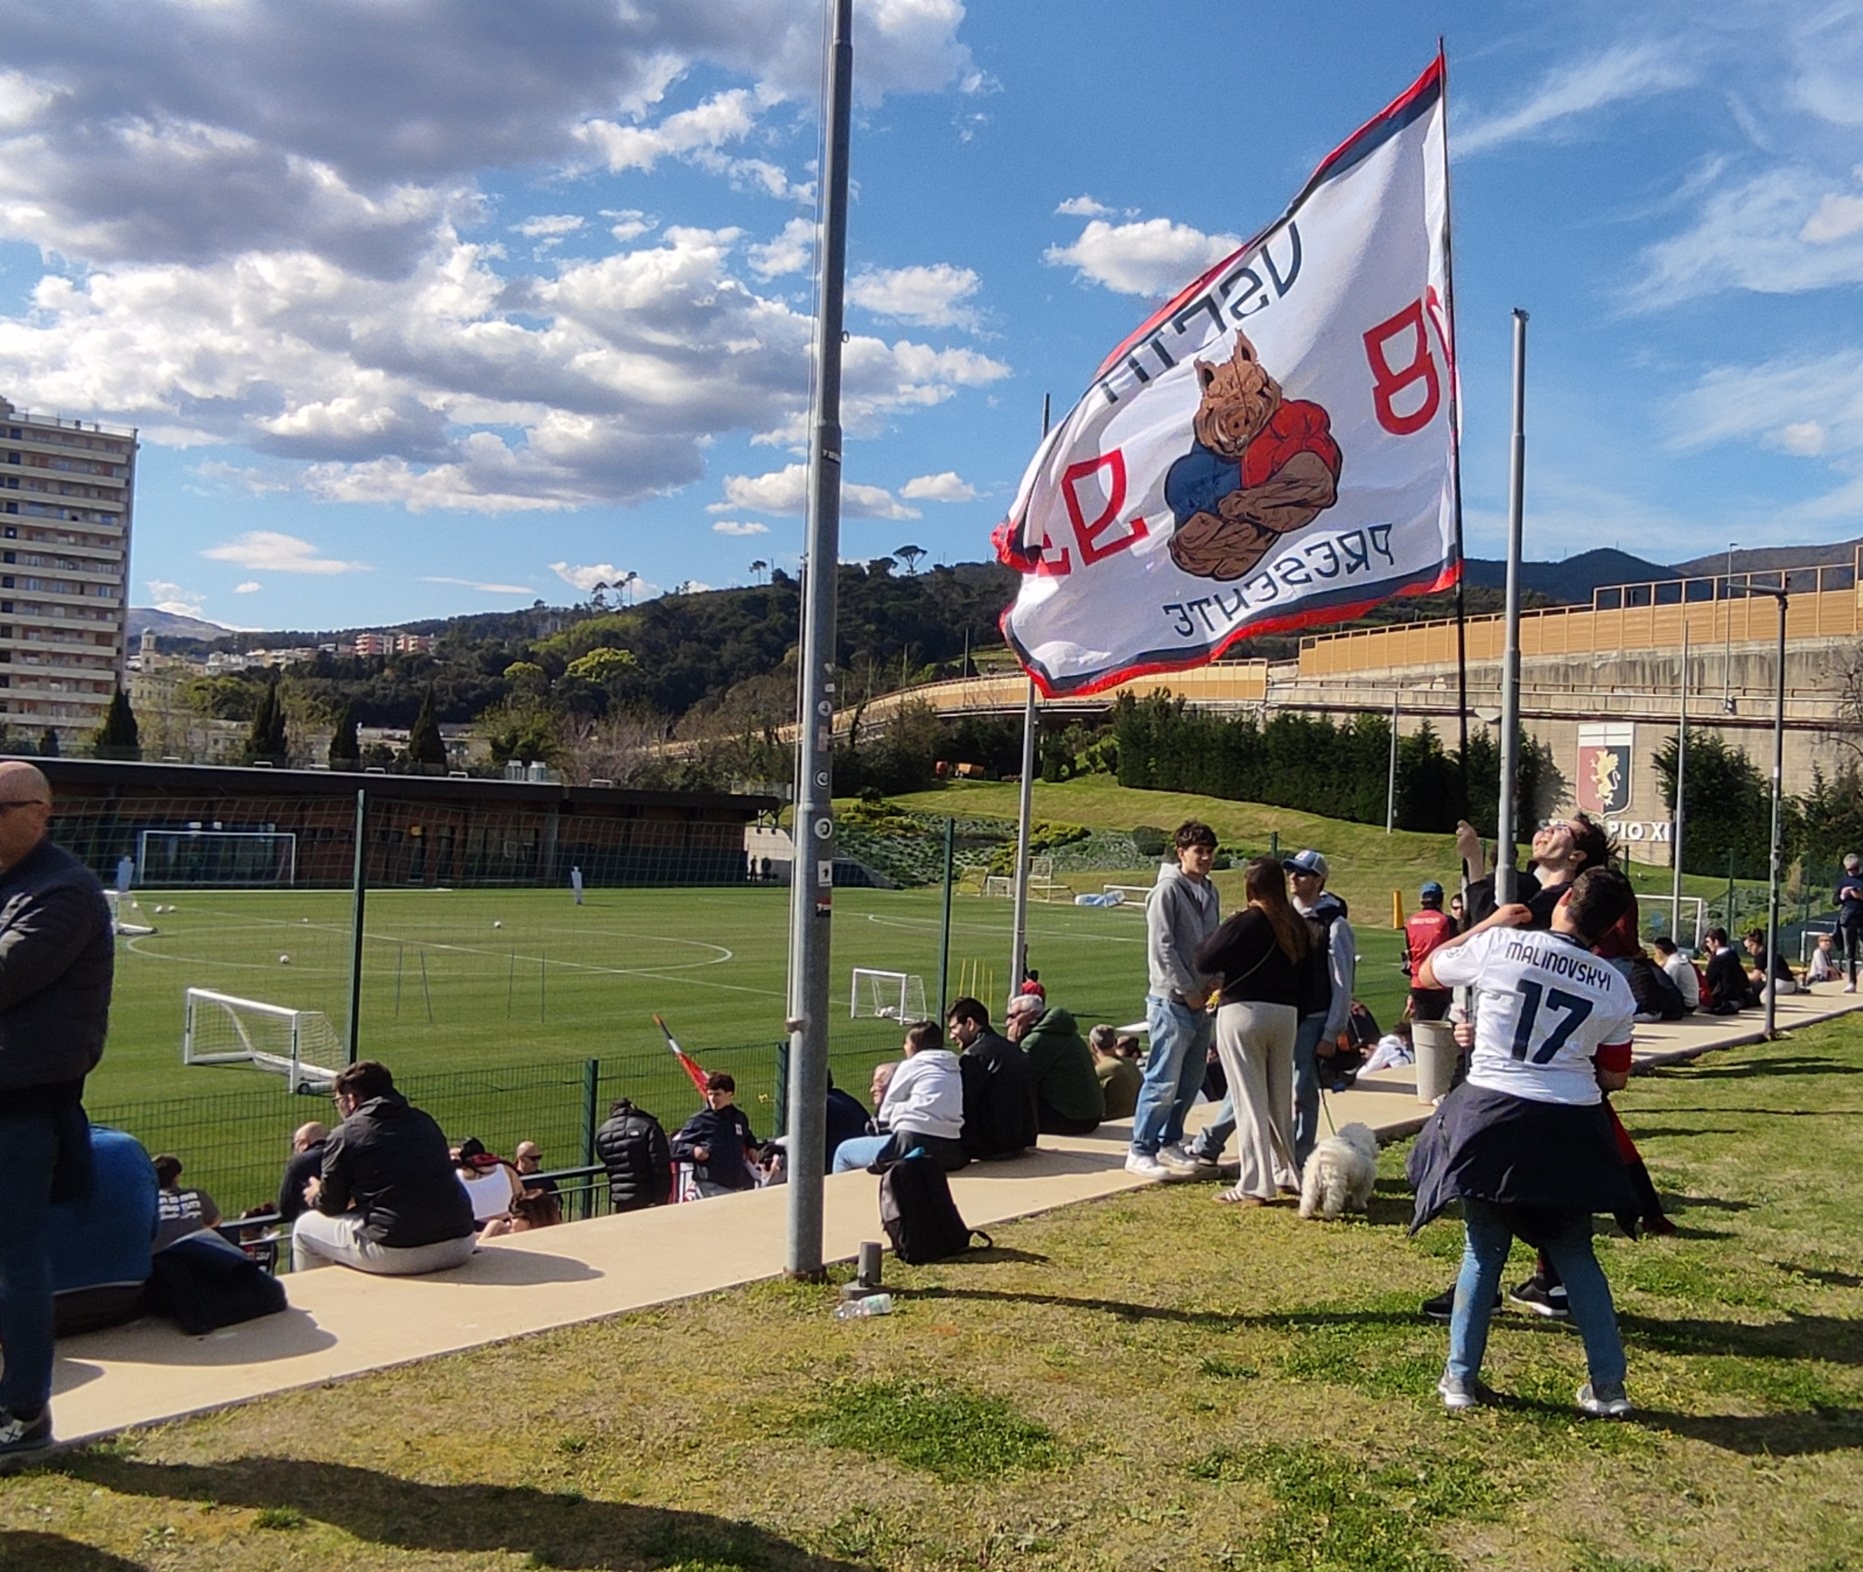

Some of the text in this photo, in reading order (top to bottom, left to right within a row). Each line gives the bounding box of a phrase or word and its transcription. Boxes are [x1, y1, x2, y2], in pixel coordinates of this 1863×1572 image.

[1607, 821, 1643, 841] PIO
[1505, 941, 1612, 992] MALINOVSKYI
[1511, 978, 1594, 1065] 17
